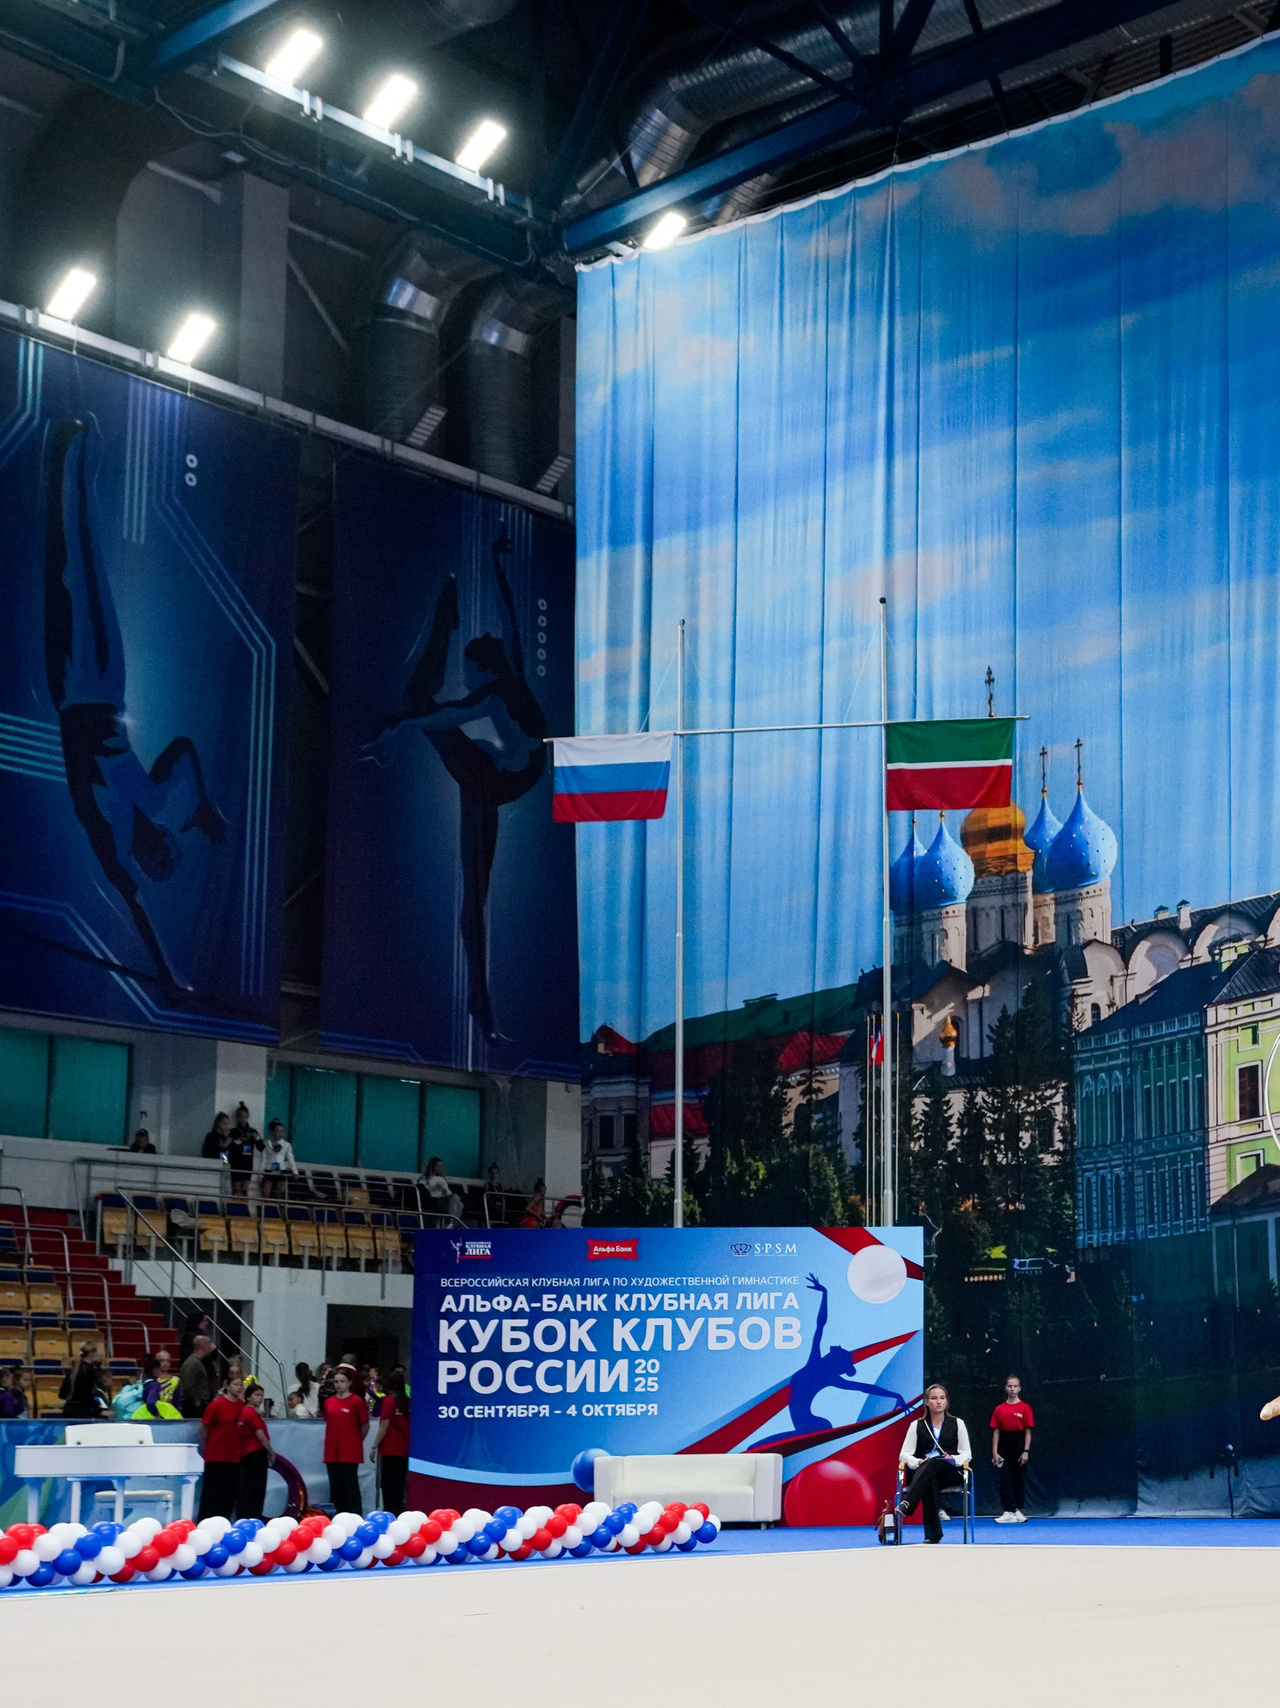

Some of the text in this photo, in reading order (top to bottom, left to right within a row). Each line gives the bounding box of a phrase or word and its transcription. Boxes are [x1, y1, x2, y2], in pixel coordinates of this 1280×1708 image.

[465, 1248, 491, 1256] ЛИГА
[593, 1245, 632, 1255] Альфа Банк
[441, 1275, 799, 1287] ВСЕРОССИЙСКАЯ КЛУБНАЯ ЛИГА ПО ХУДОЖЕСТВЕННОЙ ГИМНАСТИКЕ
[440, 1292, 799, 1312] АЛЬФА-БАНК КЛУБНАЯ ЛИГА
[439, 1316, 801, 1353] КУБОК КЛУБОВ
[634, 1358, 660, 1374] 20
[438, 1359, 629, 1394] РОССИИ
[634, 1376, 659, 1392] 25
[438, 1406, 459, 1418] 30
[464, 1404, 549, 1418] СЕНТЯБРЯ
[566, 1404, 577, 1415] 4
[582, 1403, 658, 1416] ОКТЯБРЯ
